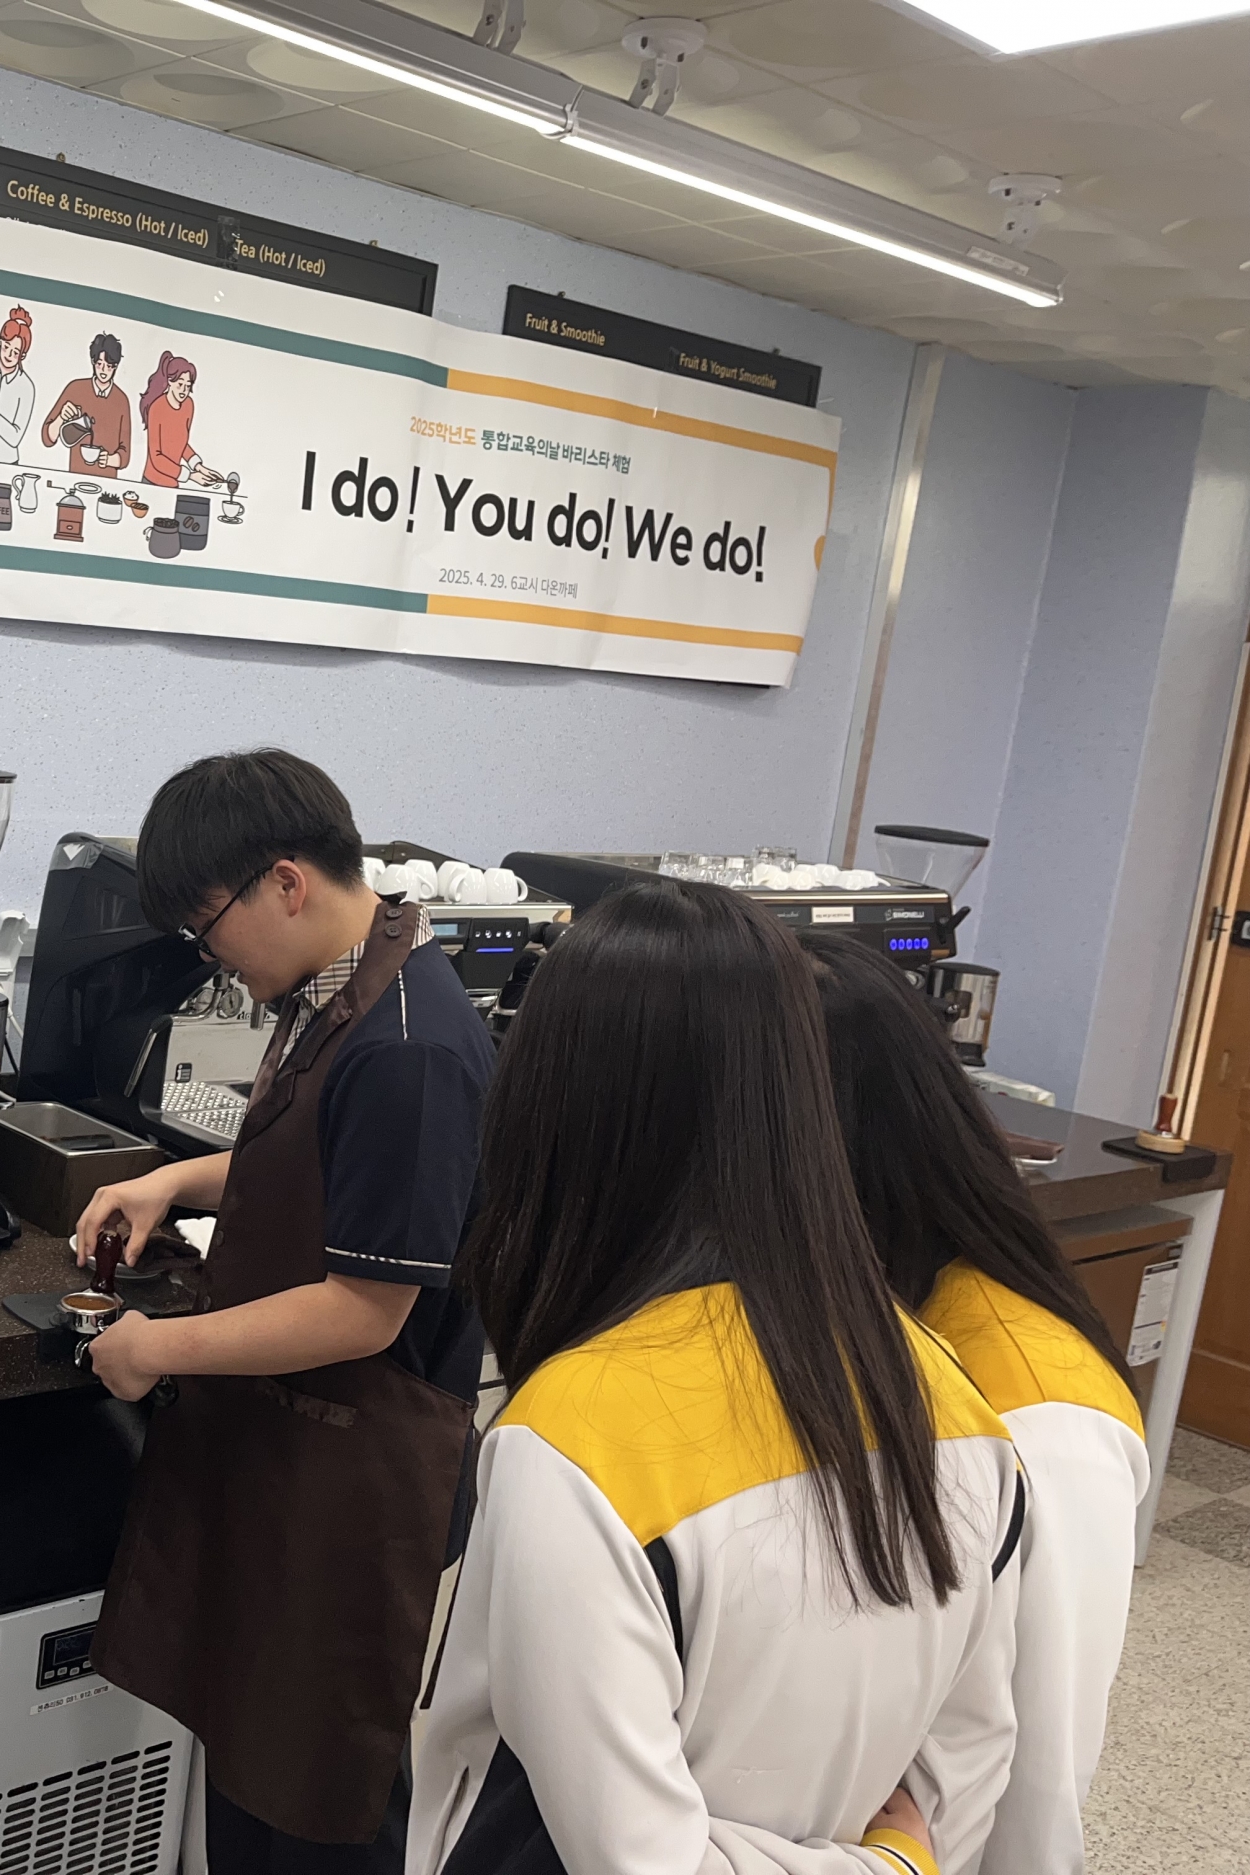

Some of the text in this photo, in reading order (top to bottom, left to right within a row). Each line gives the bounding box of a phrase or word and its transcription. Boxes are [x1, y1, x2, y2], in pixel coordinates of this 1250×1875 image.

[7, 180, 55, 207] Coffee
[59, 193, 70, 211] &
[74, 197, 132, 227] Espresso
[136, 212, 166, 237] (Hot
[167, 222, 176, 239] /
[177, 224, 209, 248] Iced)
[235, 239, 256, 259] Tea
[259, 244, 287, 267] (Hot
[296, 255, 326, 278] Iced)
[525, 313, 606, 346] Fruit & Smoothie
[679, 352, 777, 389] Fruit & Yogurt Smoothie
[409, 416, 631, 475] 2025학년도 통합교육의날 바리스타 체험
[301, 450, 767, 583] I do! You do! We do!
[438, 568, 579, 599] 2025. 4. 29. 6교시 다온까페
